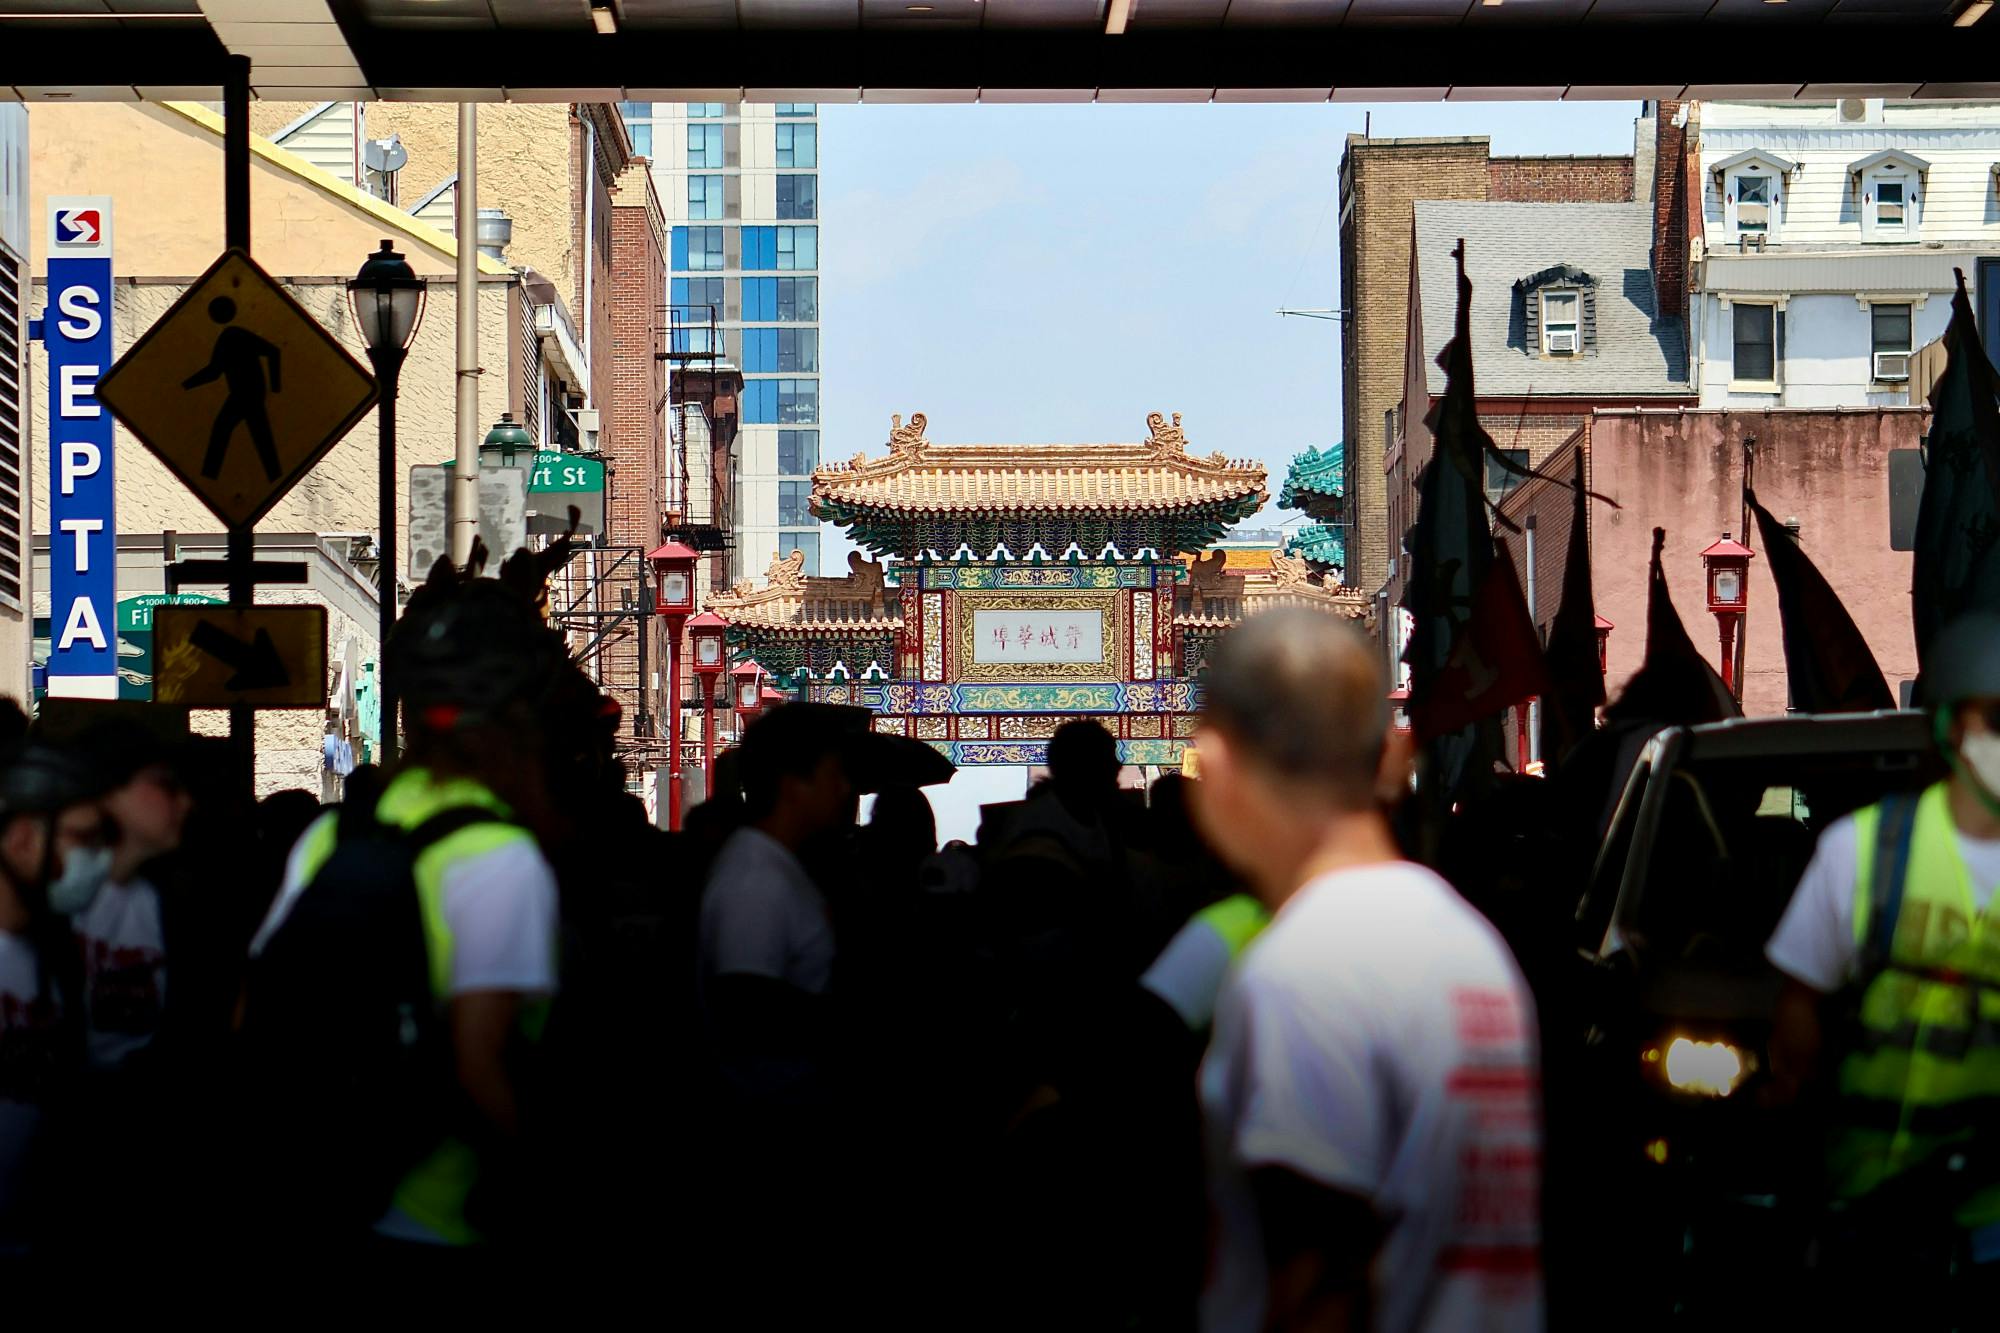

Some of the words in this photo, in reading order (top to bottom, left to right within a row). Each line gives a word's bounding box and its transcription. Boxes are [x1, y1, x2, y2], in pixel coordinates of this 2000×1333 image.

[57, 285, 107, 649] SEPTA
[533, 467, 552, 486] rt
[563, 467, 586, 486] St
[145, 598, 166, 606] 1000
[169, 597, 180, 605] W
[183, 598, 200, 606] 900
[131, 608, 153, 626] Fi
